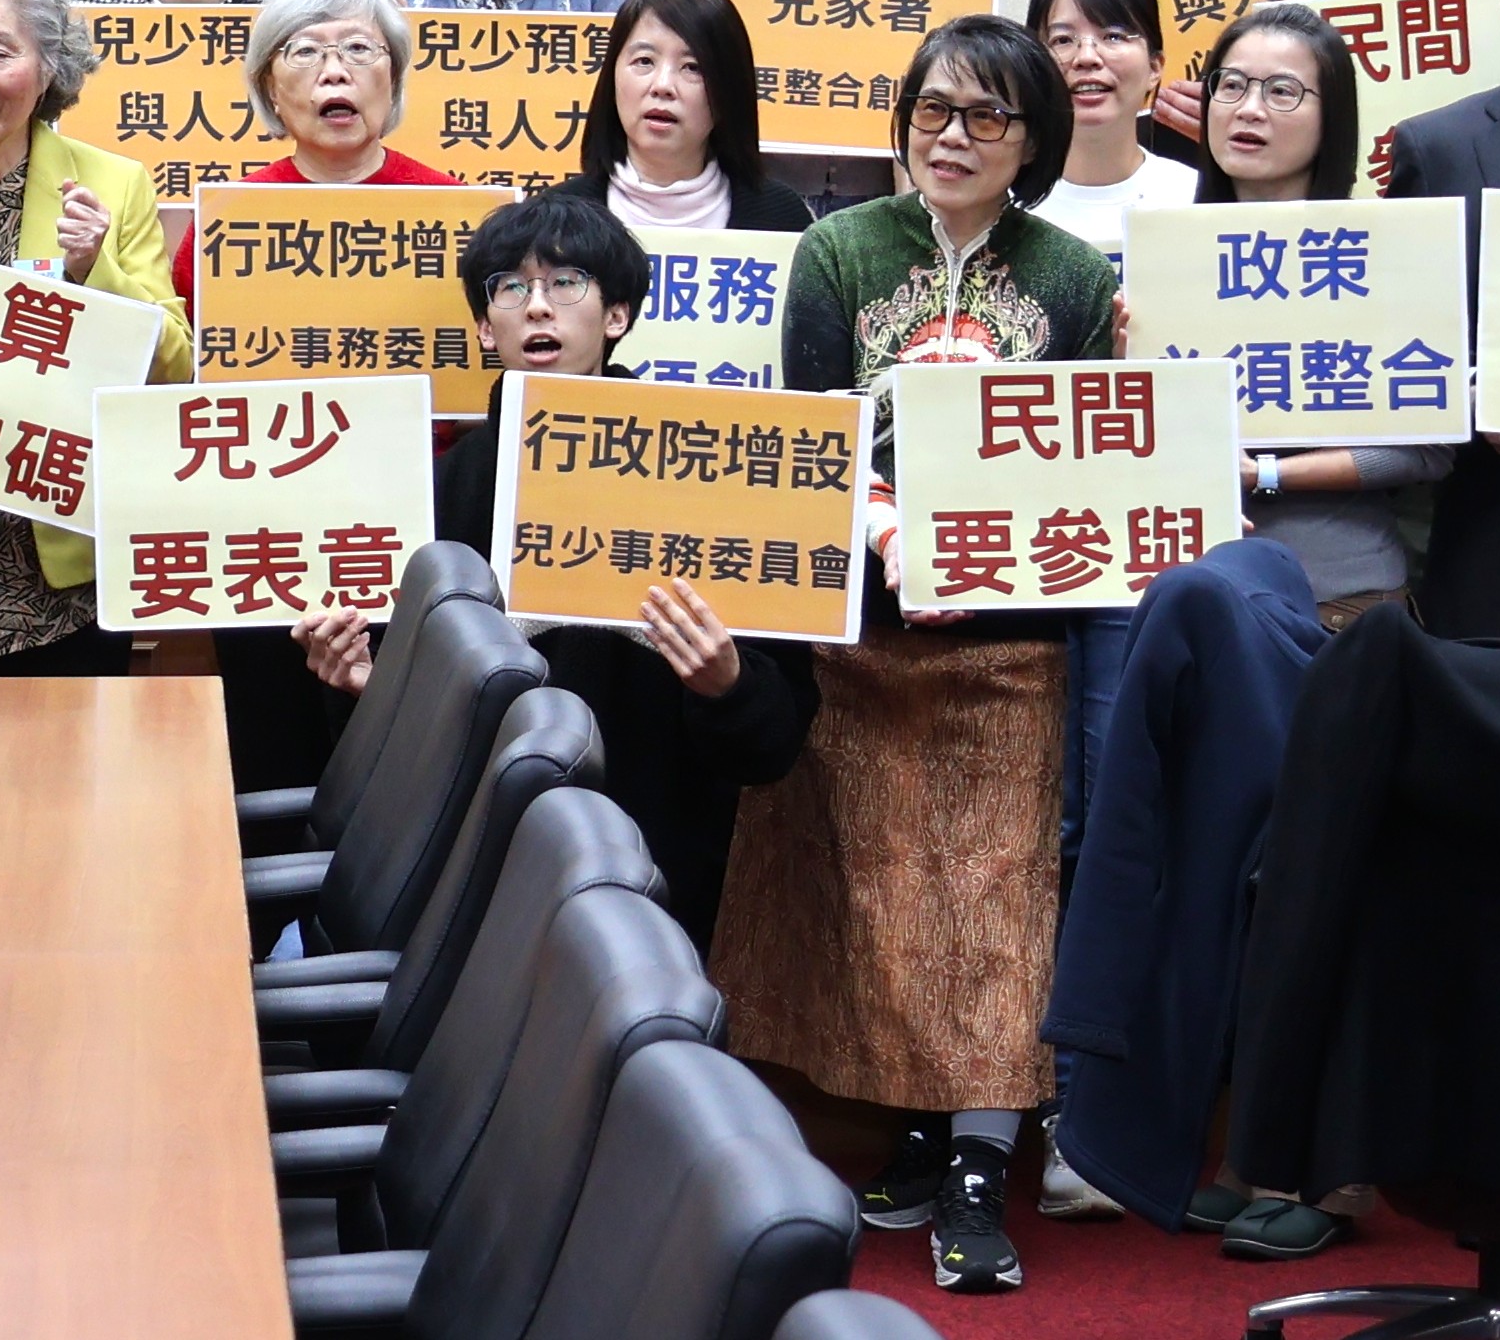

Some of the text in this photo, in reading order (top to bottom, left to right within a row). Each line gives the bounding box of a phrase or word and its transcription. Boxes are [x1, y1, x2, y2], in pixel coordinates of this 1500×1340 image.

[414, 20, 614, 75] 兒少預算
[645, 254, 778, 326] 服務
[1216, 227, 1369, 300] 政策
[978, 371, 1156, 460] 民間
[1159, 338, 1454, 413] 須整合
[175, 392, 351, 482] 兒少
[525, 409, 853, 494] 行政院增設
[129, 523, 404, 617] 要表意
[512, 520, 851, 593] 兒少事務委員會
[931, 505, 1203, 598] 要參與
